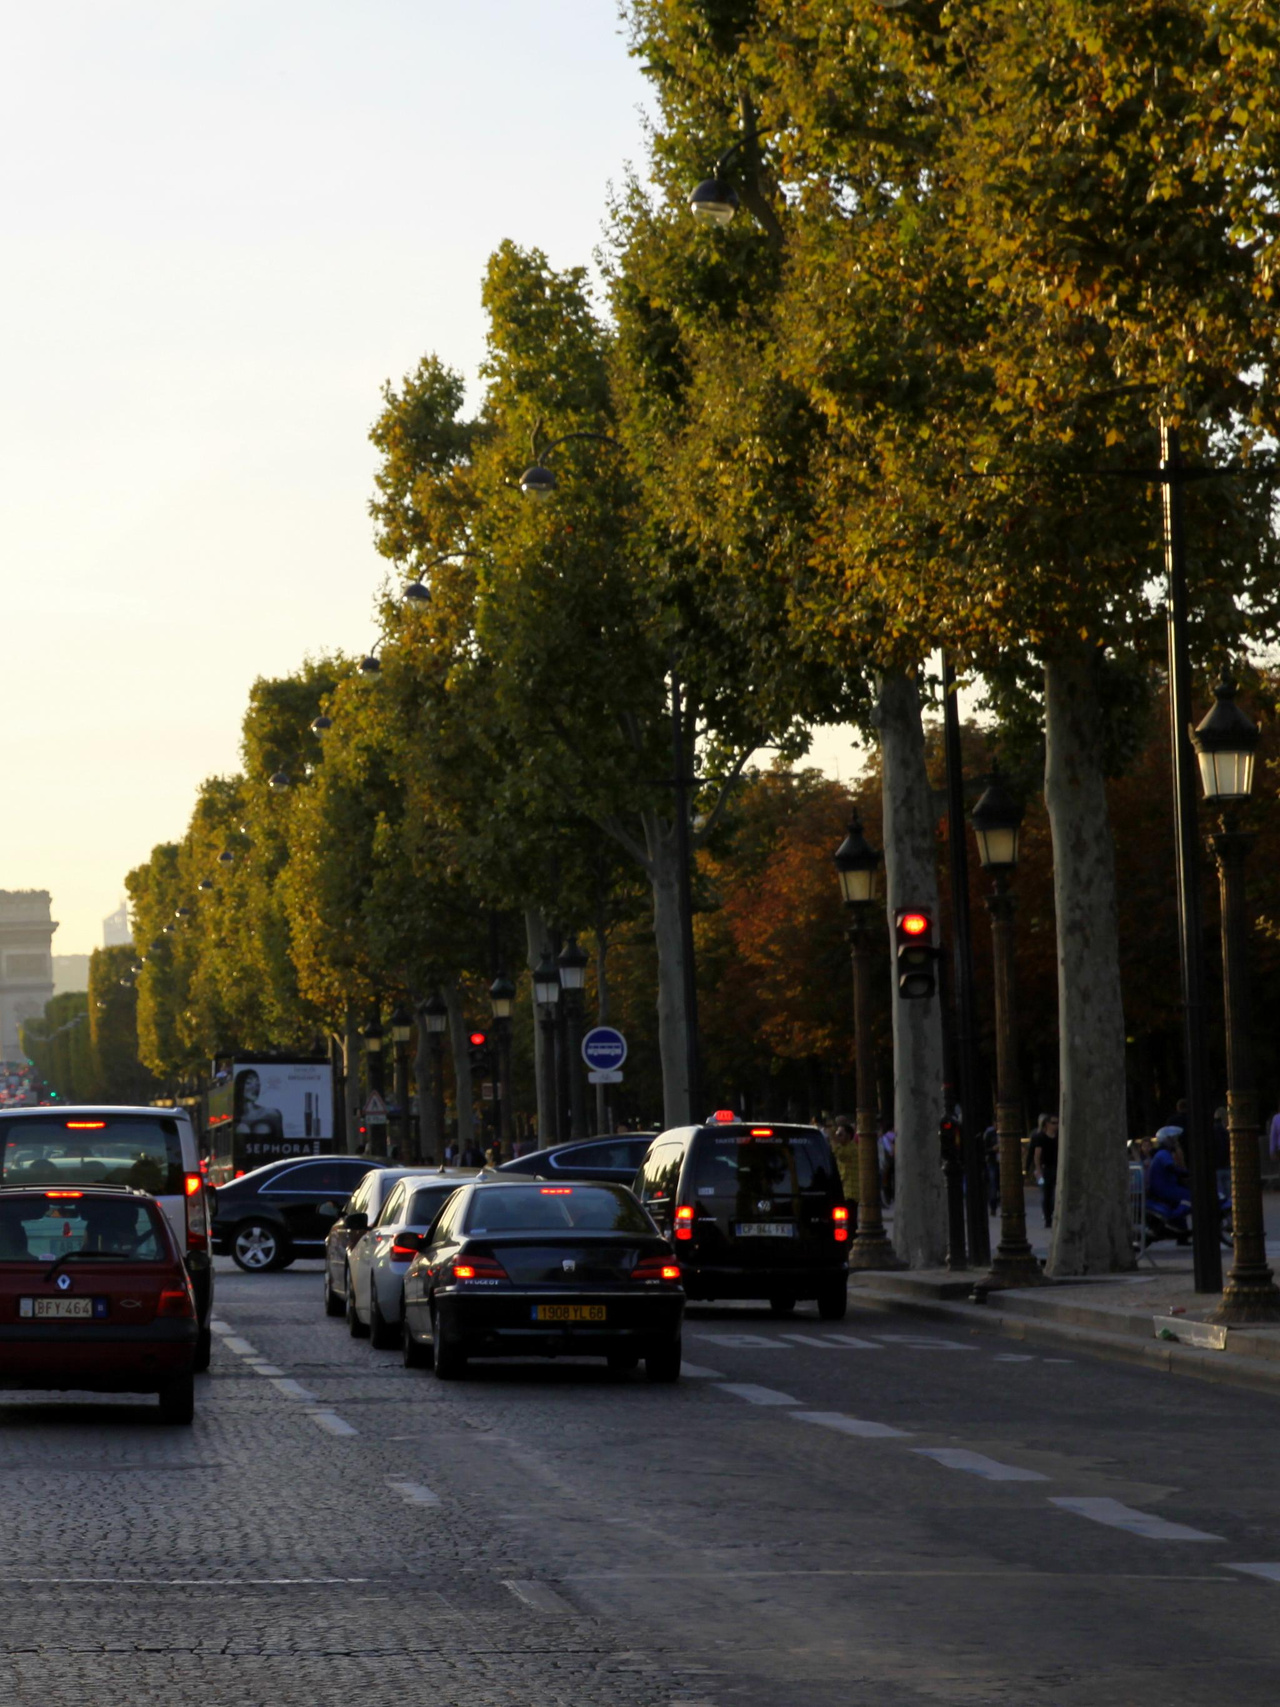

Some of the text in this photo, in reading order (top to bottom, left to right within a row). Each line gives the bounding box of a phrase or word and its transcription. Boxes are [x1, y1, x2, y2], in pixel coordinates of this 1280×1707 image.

[245, 1143, 310, 1154] SEPHORA
[542, 1306, 604, 1319] 1908 YL 68
[693, 1333, 980, 1350] BUS
